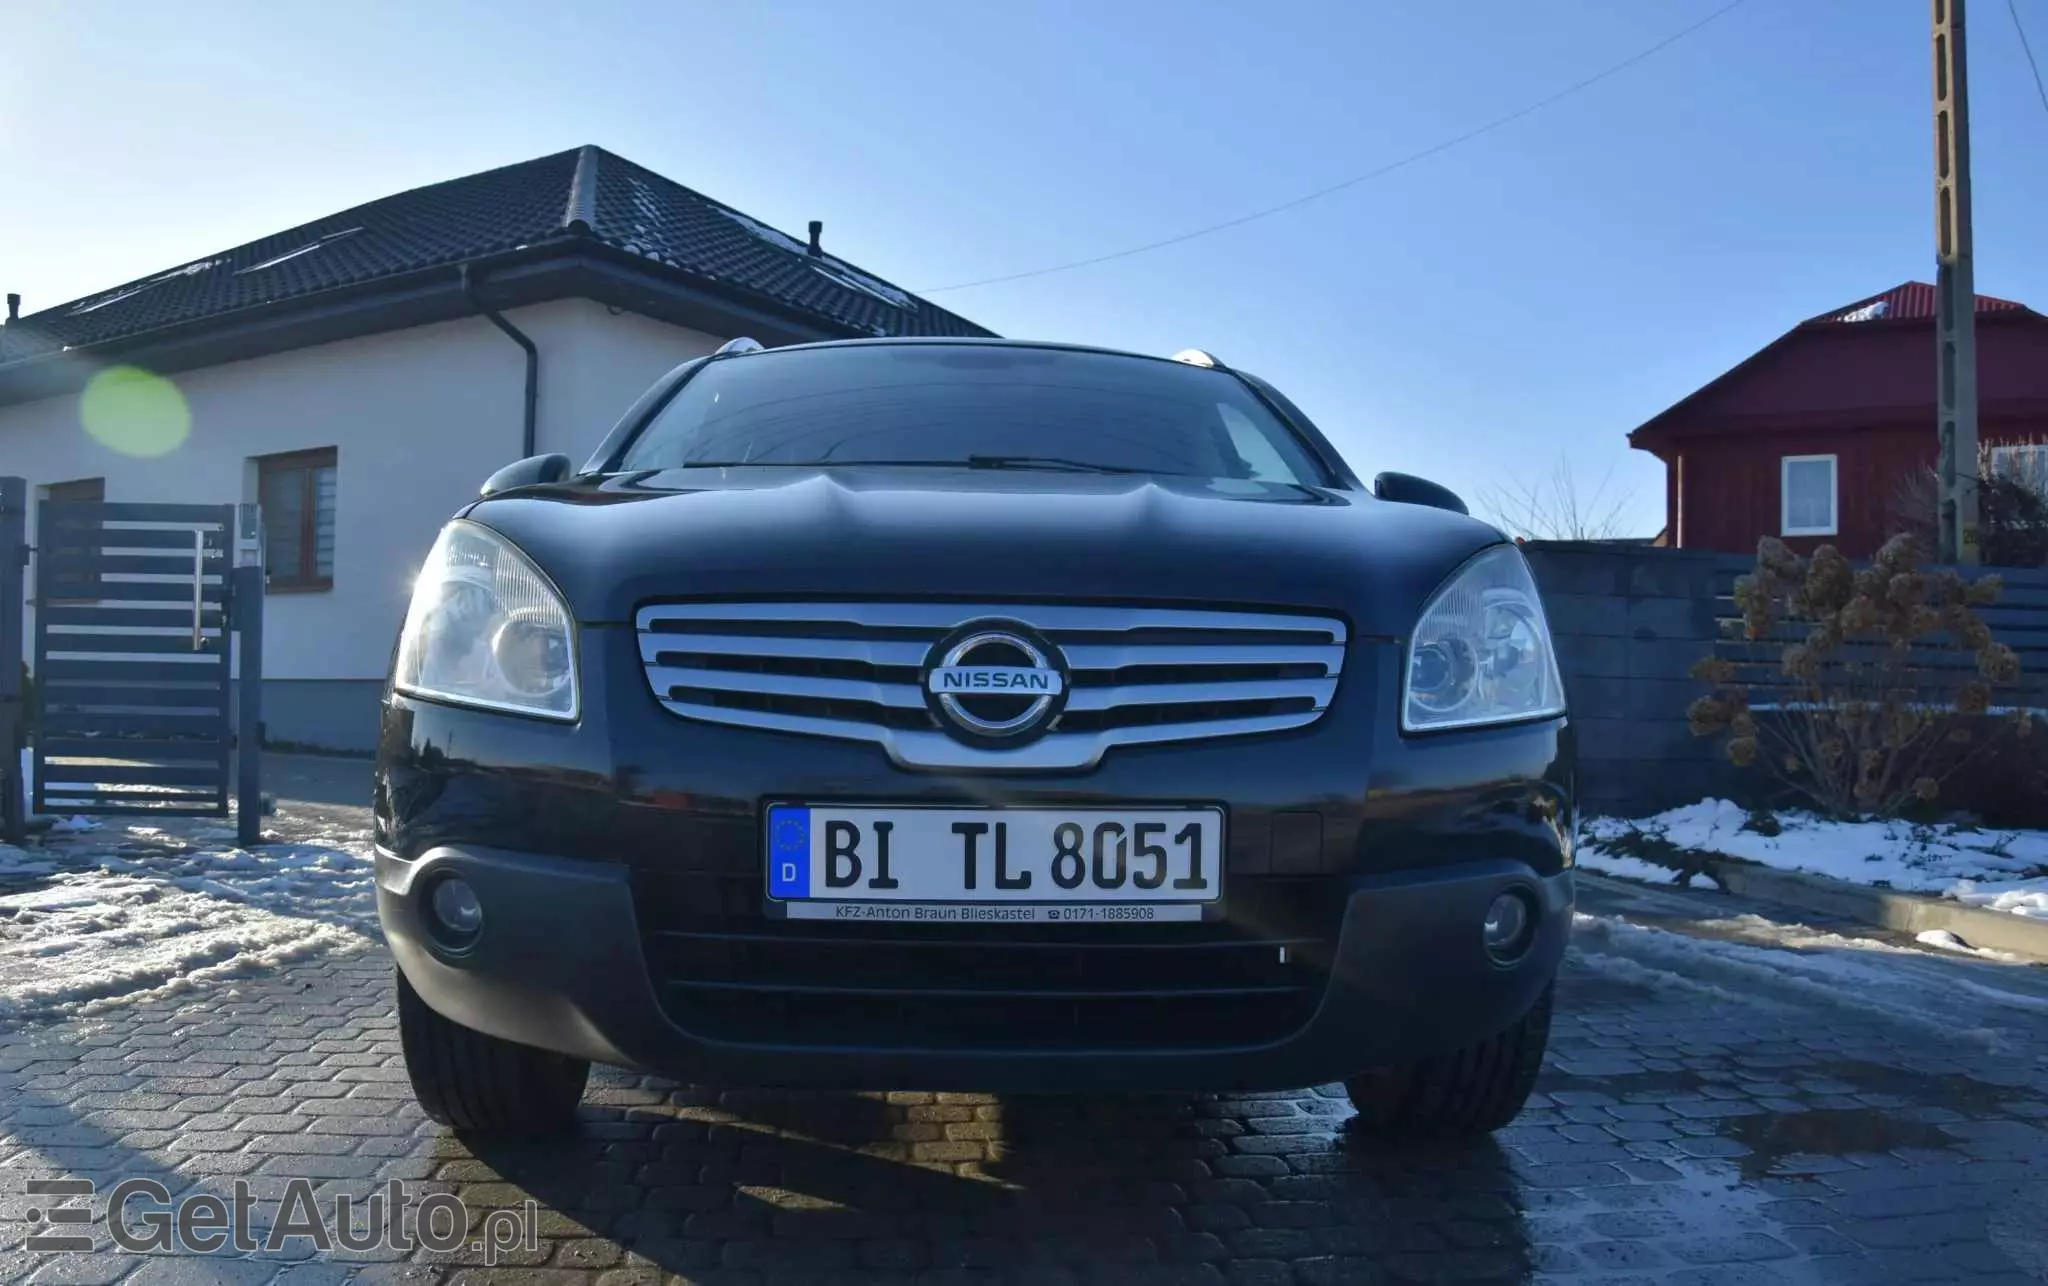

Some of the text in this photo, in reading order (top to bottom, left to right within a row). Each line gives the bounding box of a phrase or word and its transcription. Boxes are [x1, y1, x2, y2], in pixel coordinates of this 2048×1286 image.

[943, 671, 1049, 690] NISSAN
[824, 820, 1208, 890] BI TL 8051
[781, 863, 797, 882] D
[835, 906, 1154, 921] KFZ-Anton Braun Blieskastel 0171-1885908
